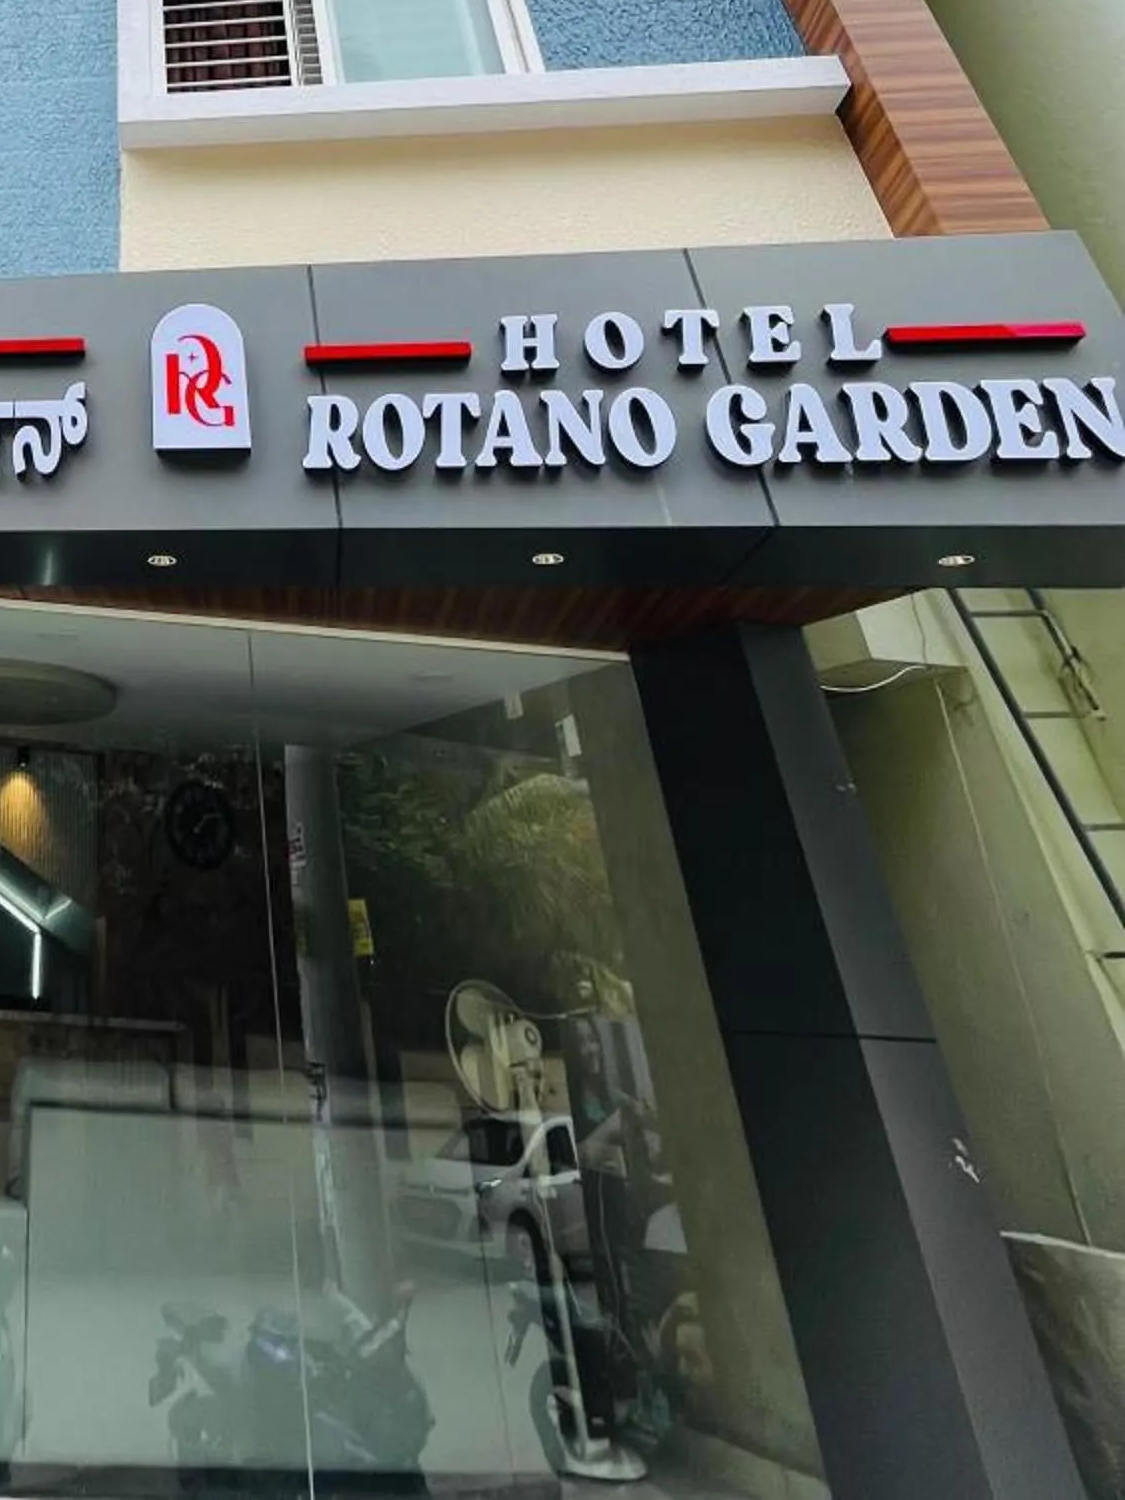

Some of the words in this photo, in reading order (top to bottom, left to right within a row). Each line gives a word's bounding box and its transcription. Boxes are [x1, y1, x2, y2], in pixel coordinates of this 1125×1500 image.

[499, 303, 883, 373] HOTEL
[301, 386, 676, 471] ROTANO
[706, 376, 1125, 467] GARDEN
